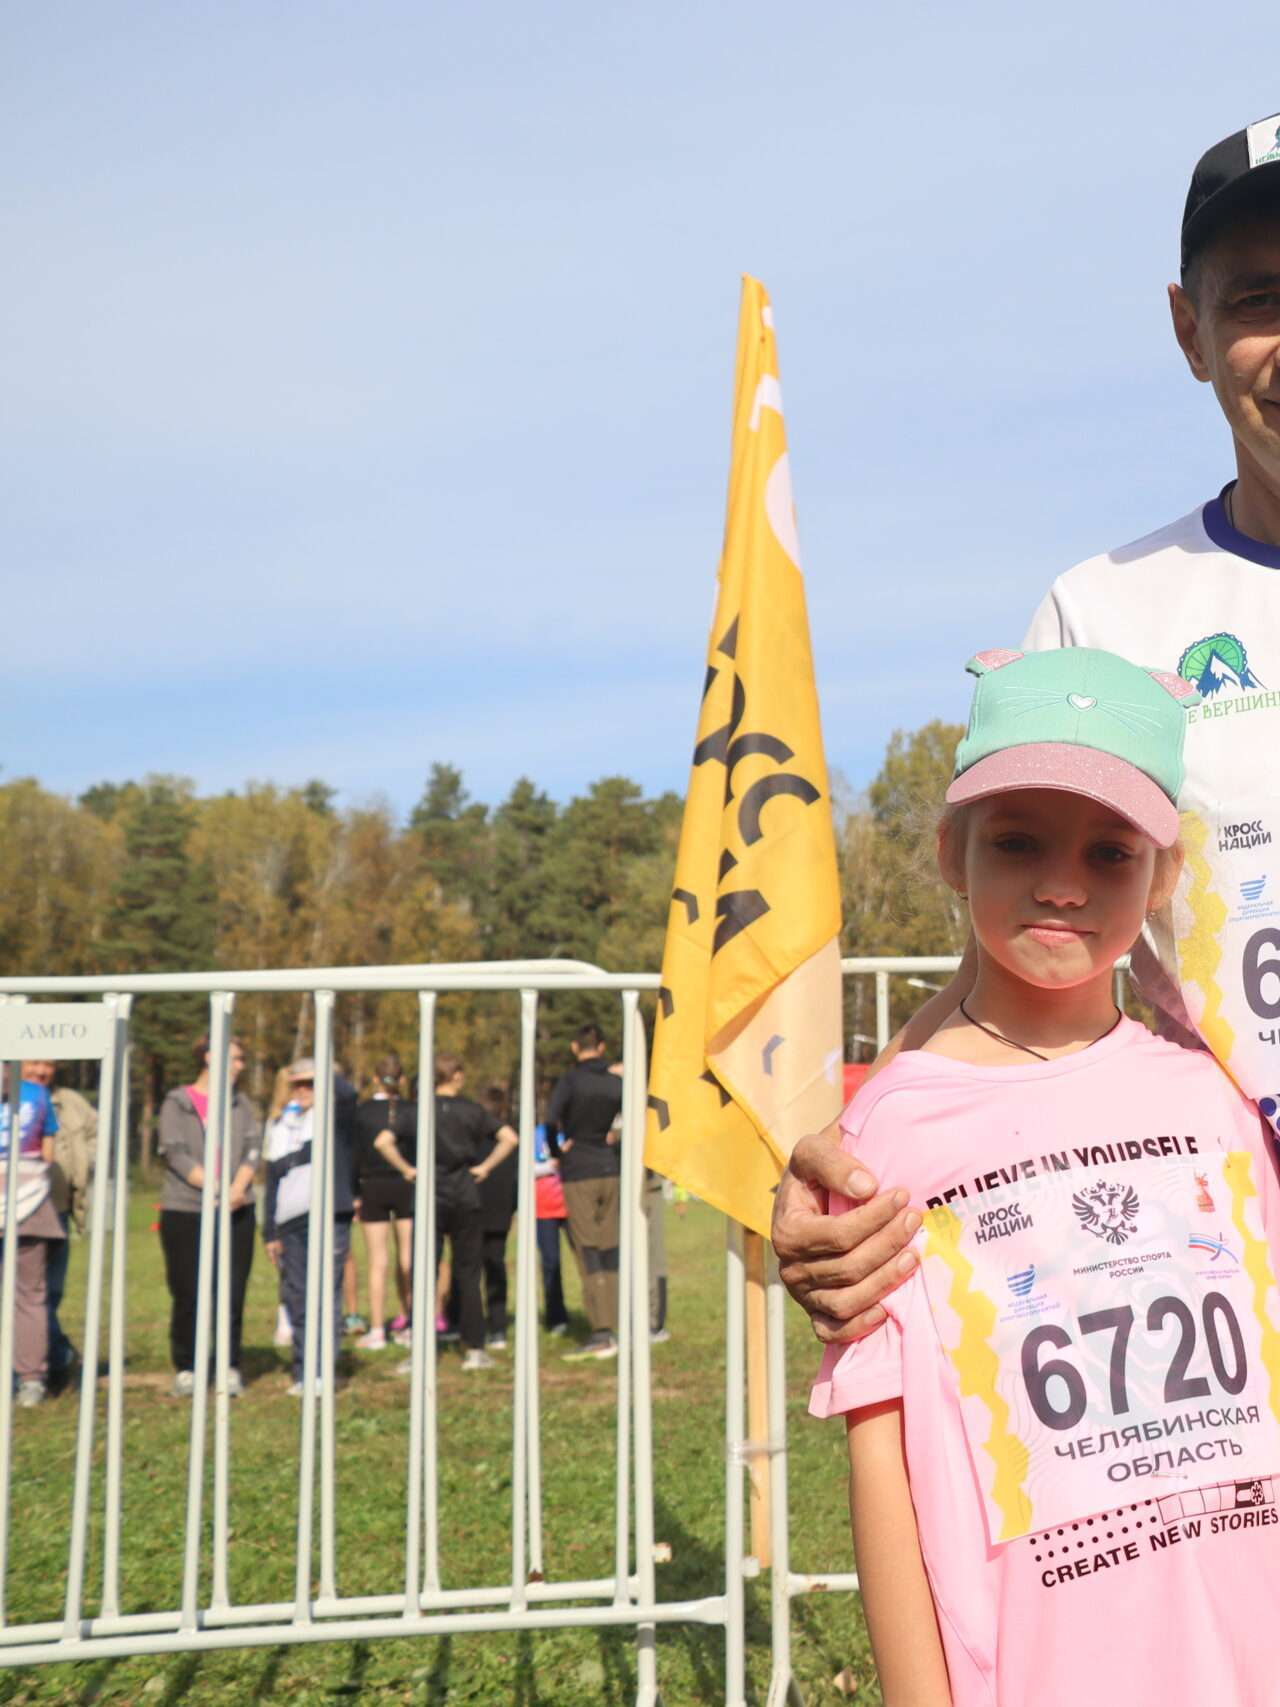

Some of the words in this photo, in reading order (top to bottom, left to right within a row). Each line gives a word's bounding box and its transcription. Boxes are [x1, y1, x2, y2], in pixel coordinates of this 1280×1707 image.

[1223, 819, 1263, 838] КРОСС
[1218, 831, 1273, 853] НАЦИИ
[20, 1023, 87, 1040] АМГО
[978, 1202, 1022, 1228] КРОСС
[975, 1213, 1034, 1245] НАЦИИ
[1072, 1256, 1140, 1276] МИНИСТЕРСТВО
[1140, 1250, 1173, 1263] СПОРТА
[1109, 1266, 1145, 1279] РОССИИ
[1020, 1291, 1248, 1431] 6720
[1054, 1405, 1261, 1462] ЧЕЛЯБИНСКАЯ
[1107, 1438, 1243, 1483] ОБЛАСТЬ
[1041, 1542, 1141, 1589] CREATE
[1150, 1520, 1202, 1552] NEW
[1210, 1507, 1280, 1535] STORIES
